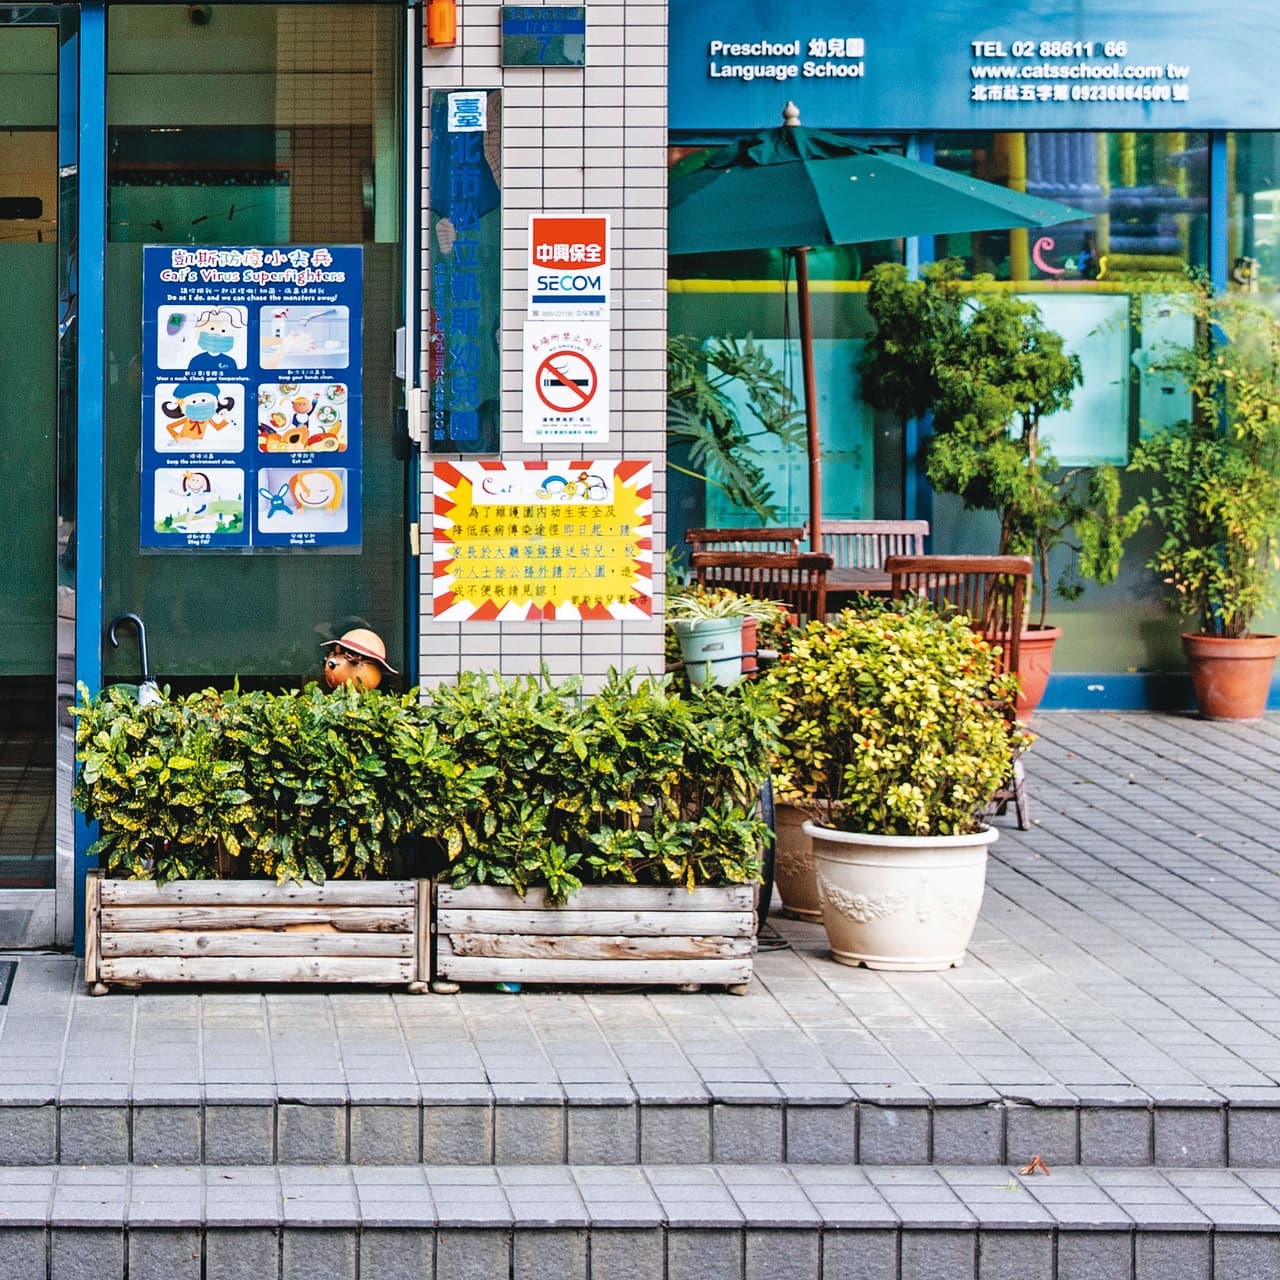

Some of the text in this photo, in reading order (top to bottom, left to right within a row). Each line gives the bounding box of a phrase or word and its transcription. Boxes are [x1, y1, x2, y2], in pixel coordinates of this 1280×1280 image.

[710, 40, 800, 56] Preschool
[971, 41, 1007, 57] TEL
[1011, 41, 1034, 57] 02
[710, 61, 864, 80] Language School
[172, 249, 333, 268] 凱斯防疫小尖兵
[537, 244, 601, 262] 中興保全
[160, 268, 346, 285] Cat's Virus Superfighters
[537, 275, 601, 291] SECOM
[468, 506, 616, 518] 為了維護園內幼生安全及
